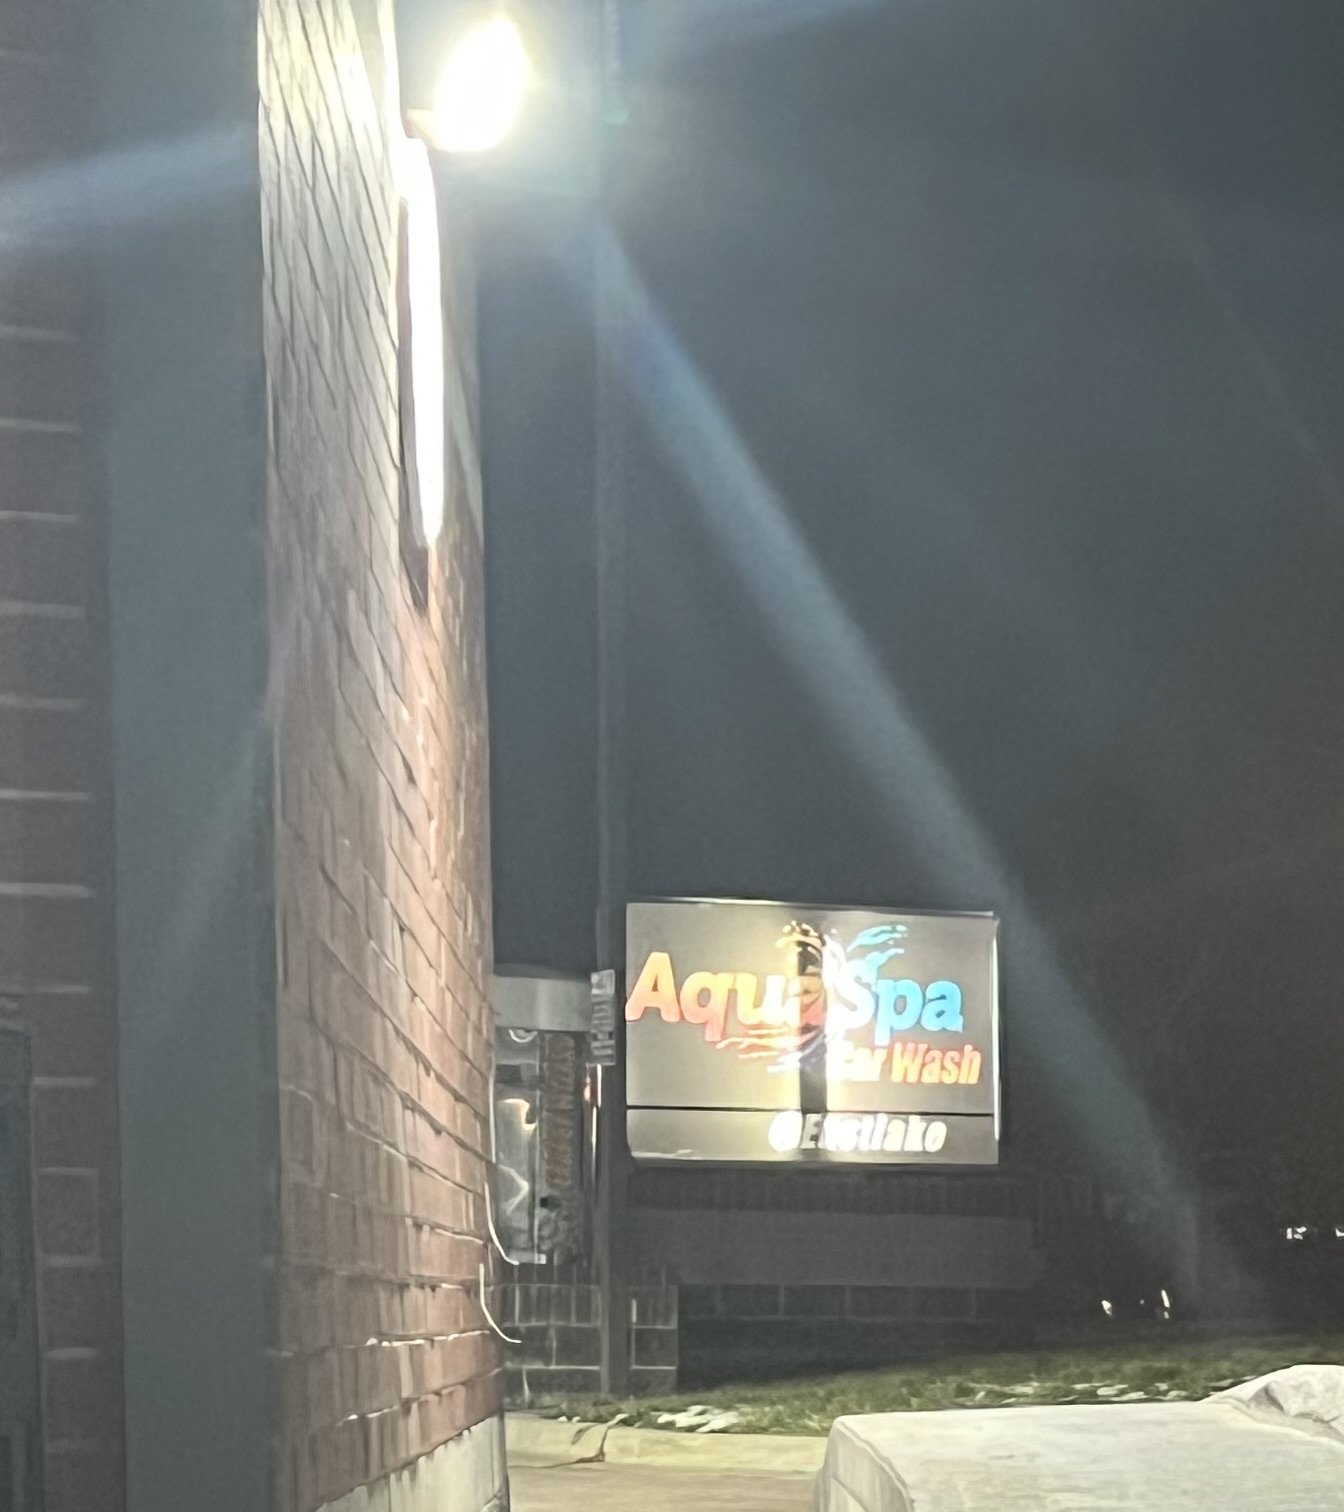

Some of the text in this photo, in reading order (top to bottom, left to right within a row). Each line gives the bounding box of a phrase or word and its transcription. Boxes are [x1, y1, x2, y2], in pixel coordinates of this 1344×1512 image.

[625, 951, 964, 1046] Aqua Spa
[890, 1042, 982, 1085] Wash
